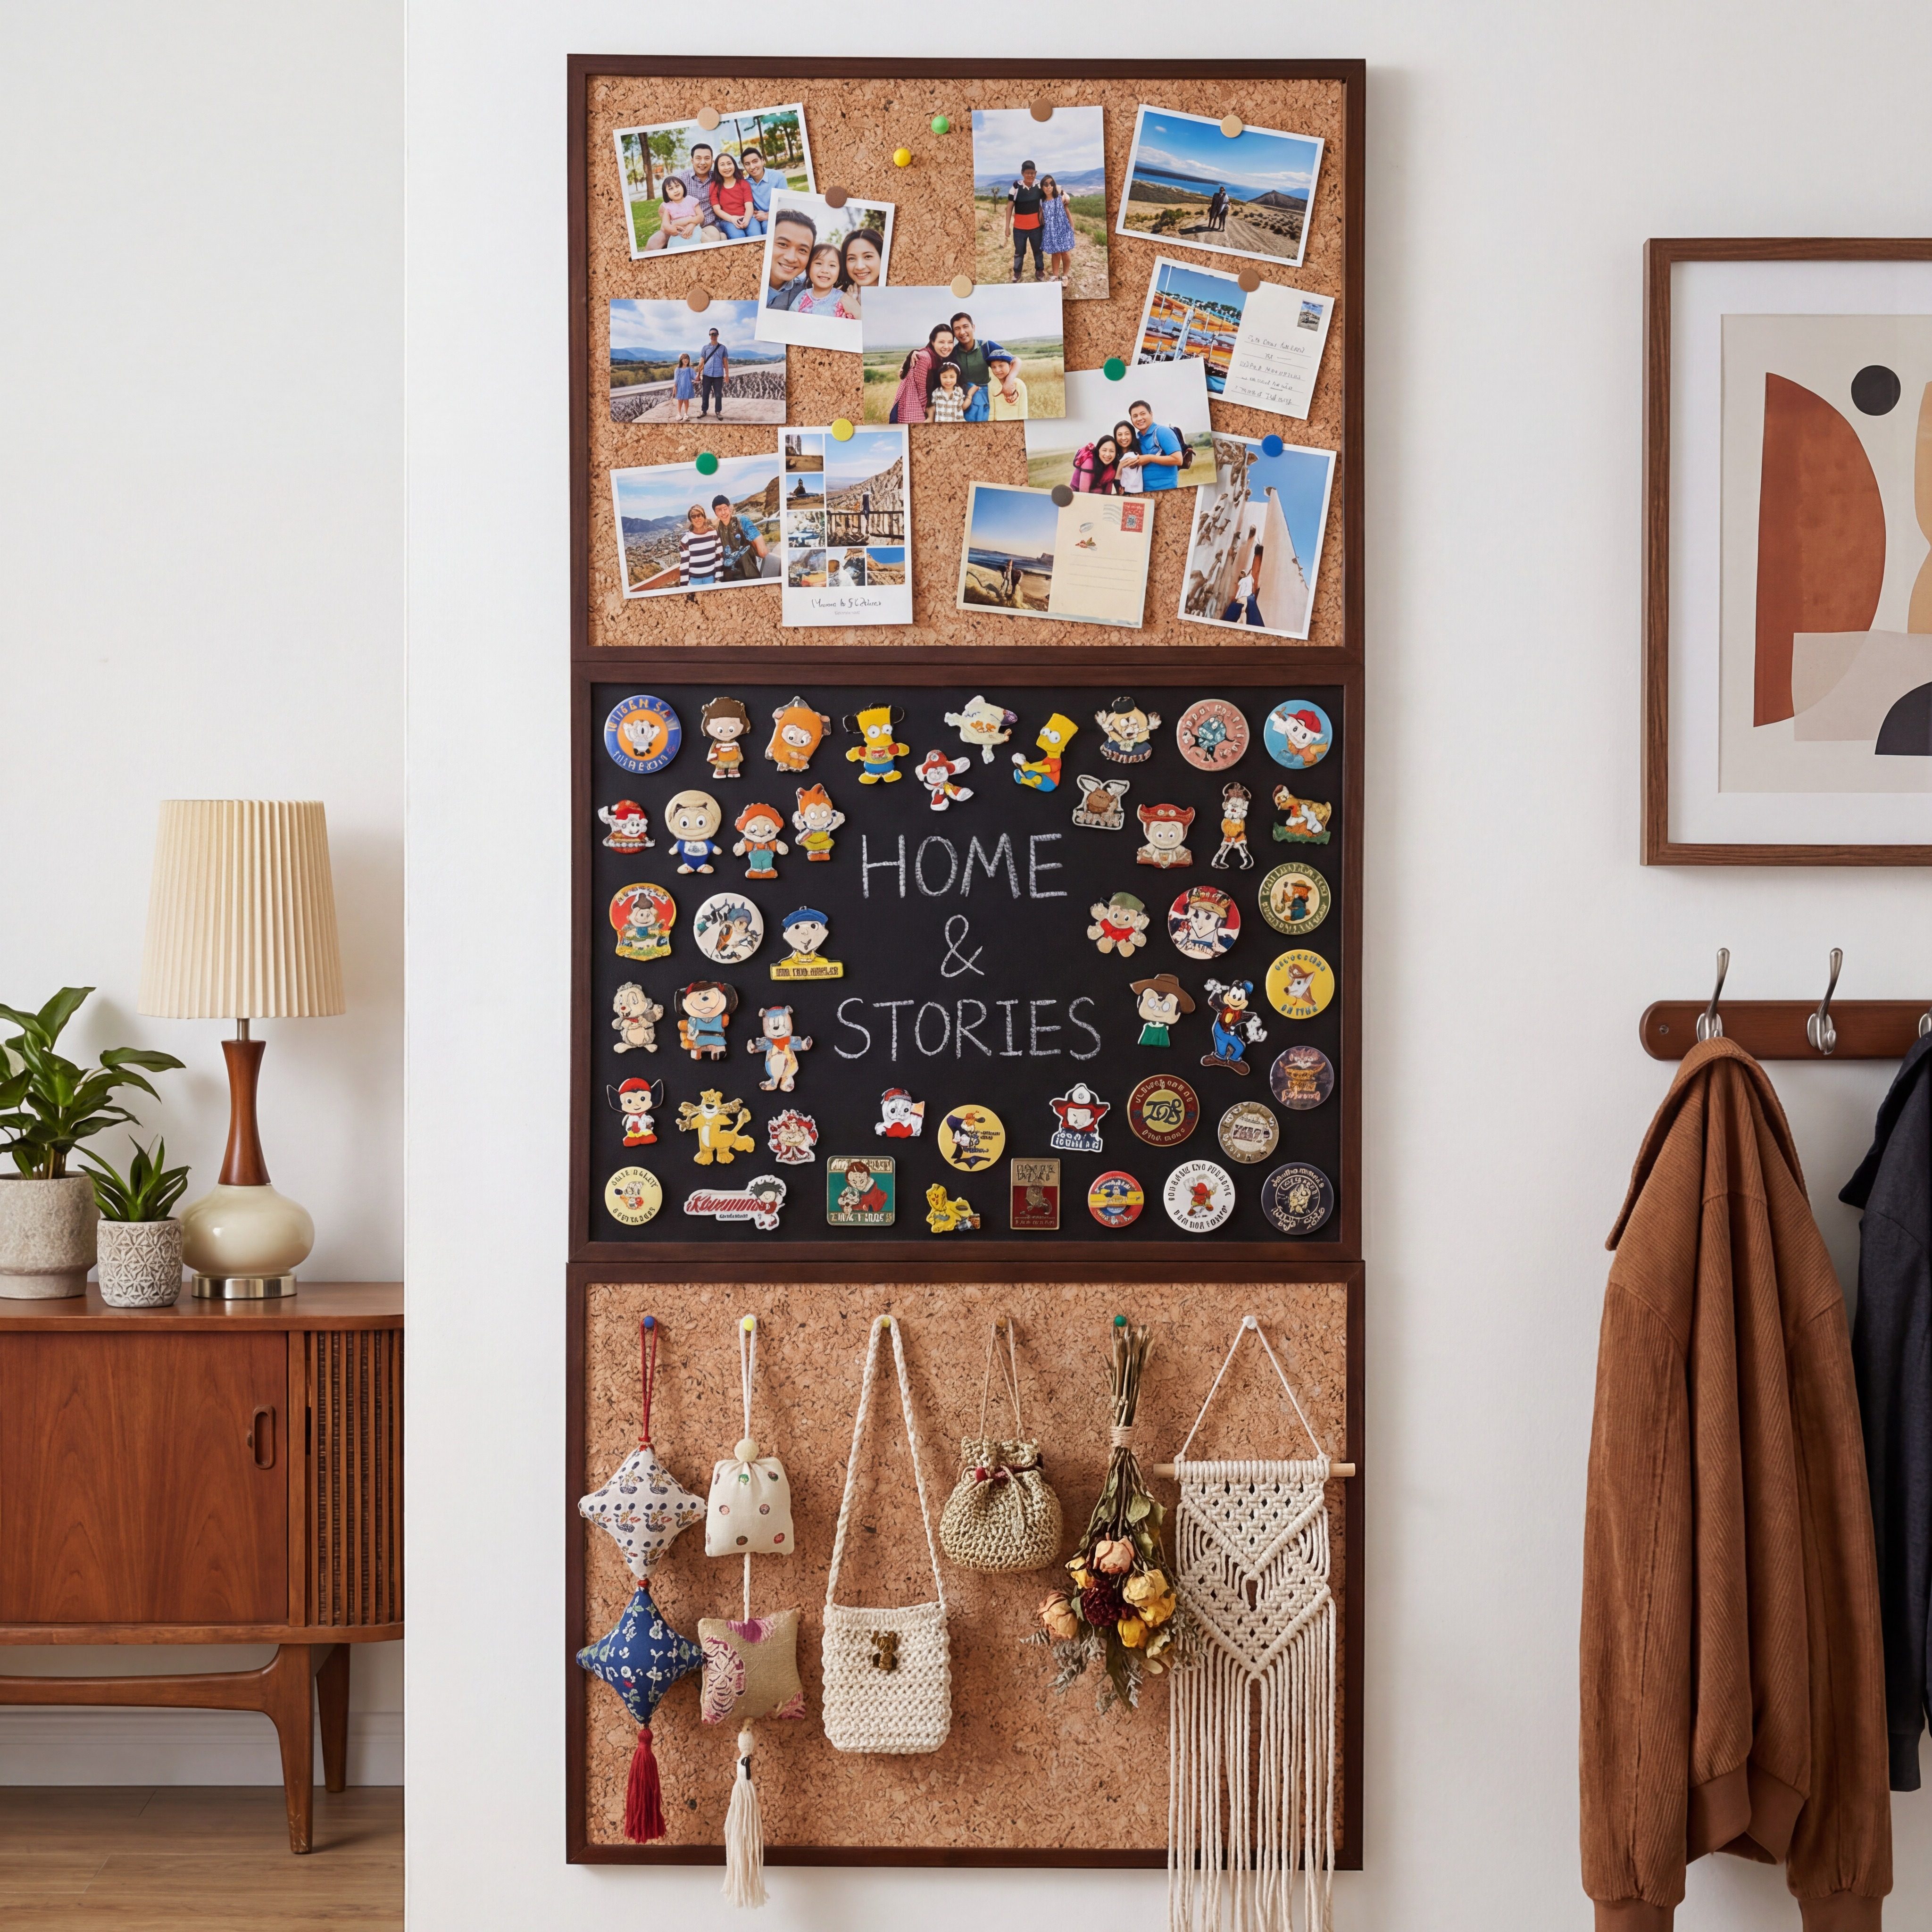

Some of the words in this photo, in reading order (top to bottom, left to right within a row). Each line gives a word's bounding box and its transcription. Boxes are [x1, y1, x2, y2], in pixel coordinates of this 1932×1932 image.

[862, 833, 1067, 898] HOME
[941, 915, 984, 977] &
[834, 997, 1100, 1061] STORIES
